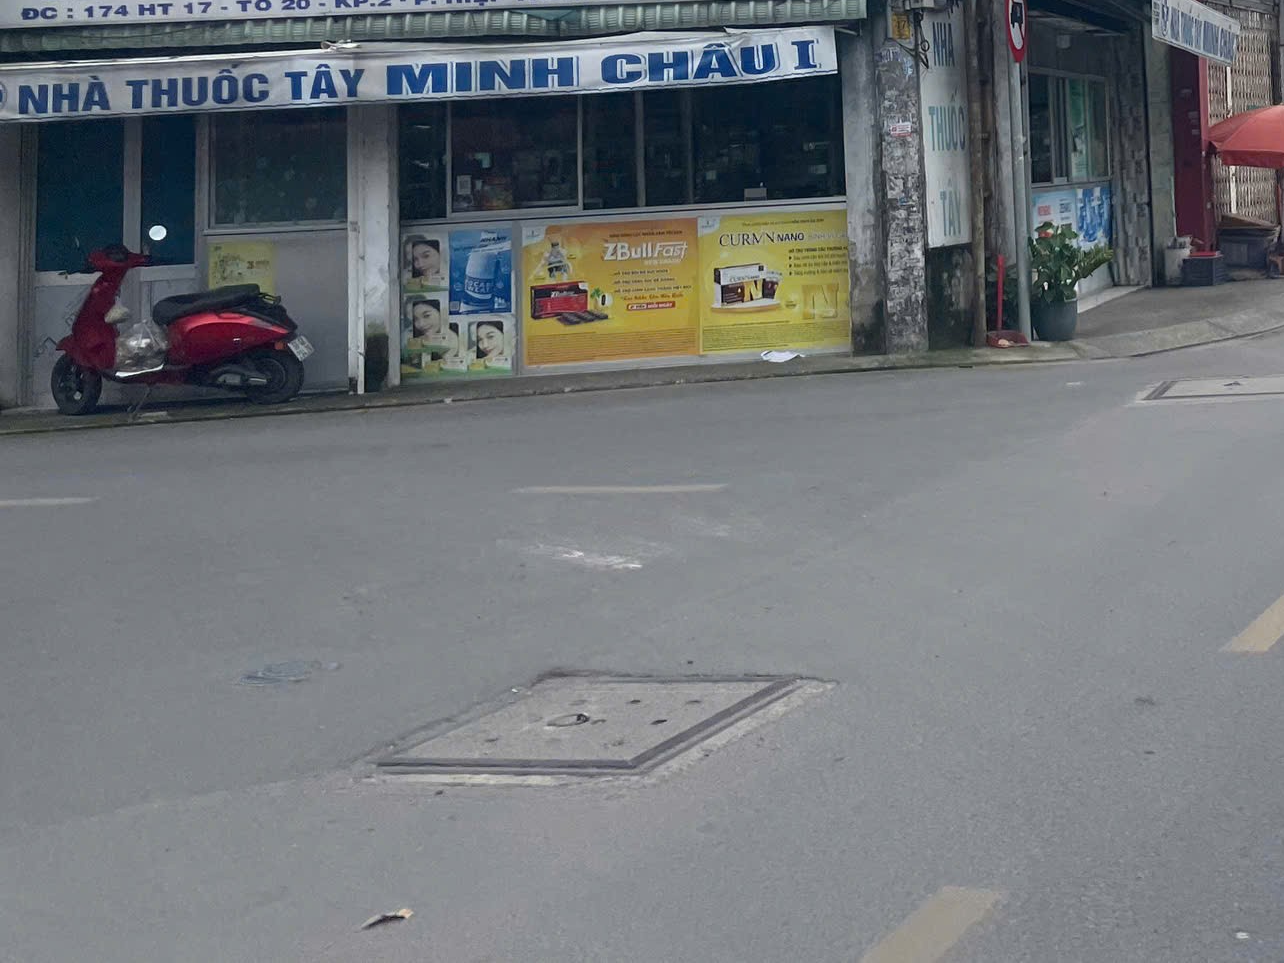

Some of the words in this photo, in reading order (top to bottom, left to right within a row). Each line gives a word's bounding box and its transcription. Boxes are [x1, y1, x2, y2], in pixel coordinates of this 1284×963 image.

[21, 6, 59, 21] ĐC
[84, 4, 129, 19] 174
[138, 2, 174, 17] HT
[183, 1, 213, 15] 17
[932, 10, 956, 68] NHÀ
[18, 74, 111, 115] NHÀ
[126, 63, 270, 109] THUỐC
[284, 63, 366, 101] TÂY
[386, 55, 580, 96] MINH
[600, 42, 781, 85] CHÂU
[793, 38, 822, 71] I
[928, 87, 967, 152] THUỐC
[939, 180, 963, 237] TÂY
